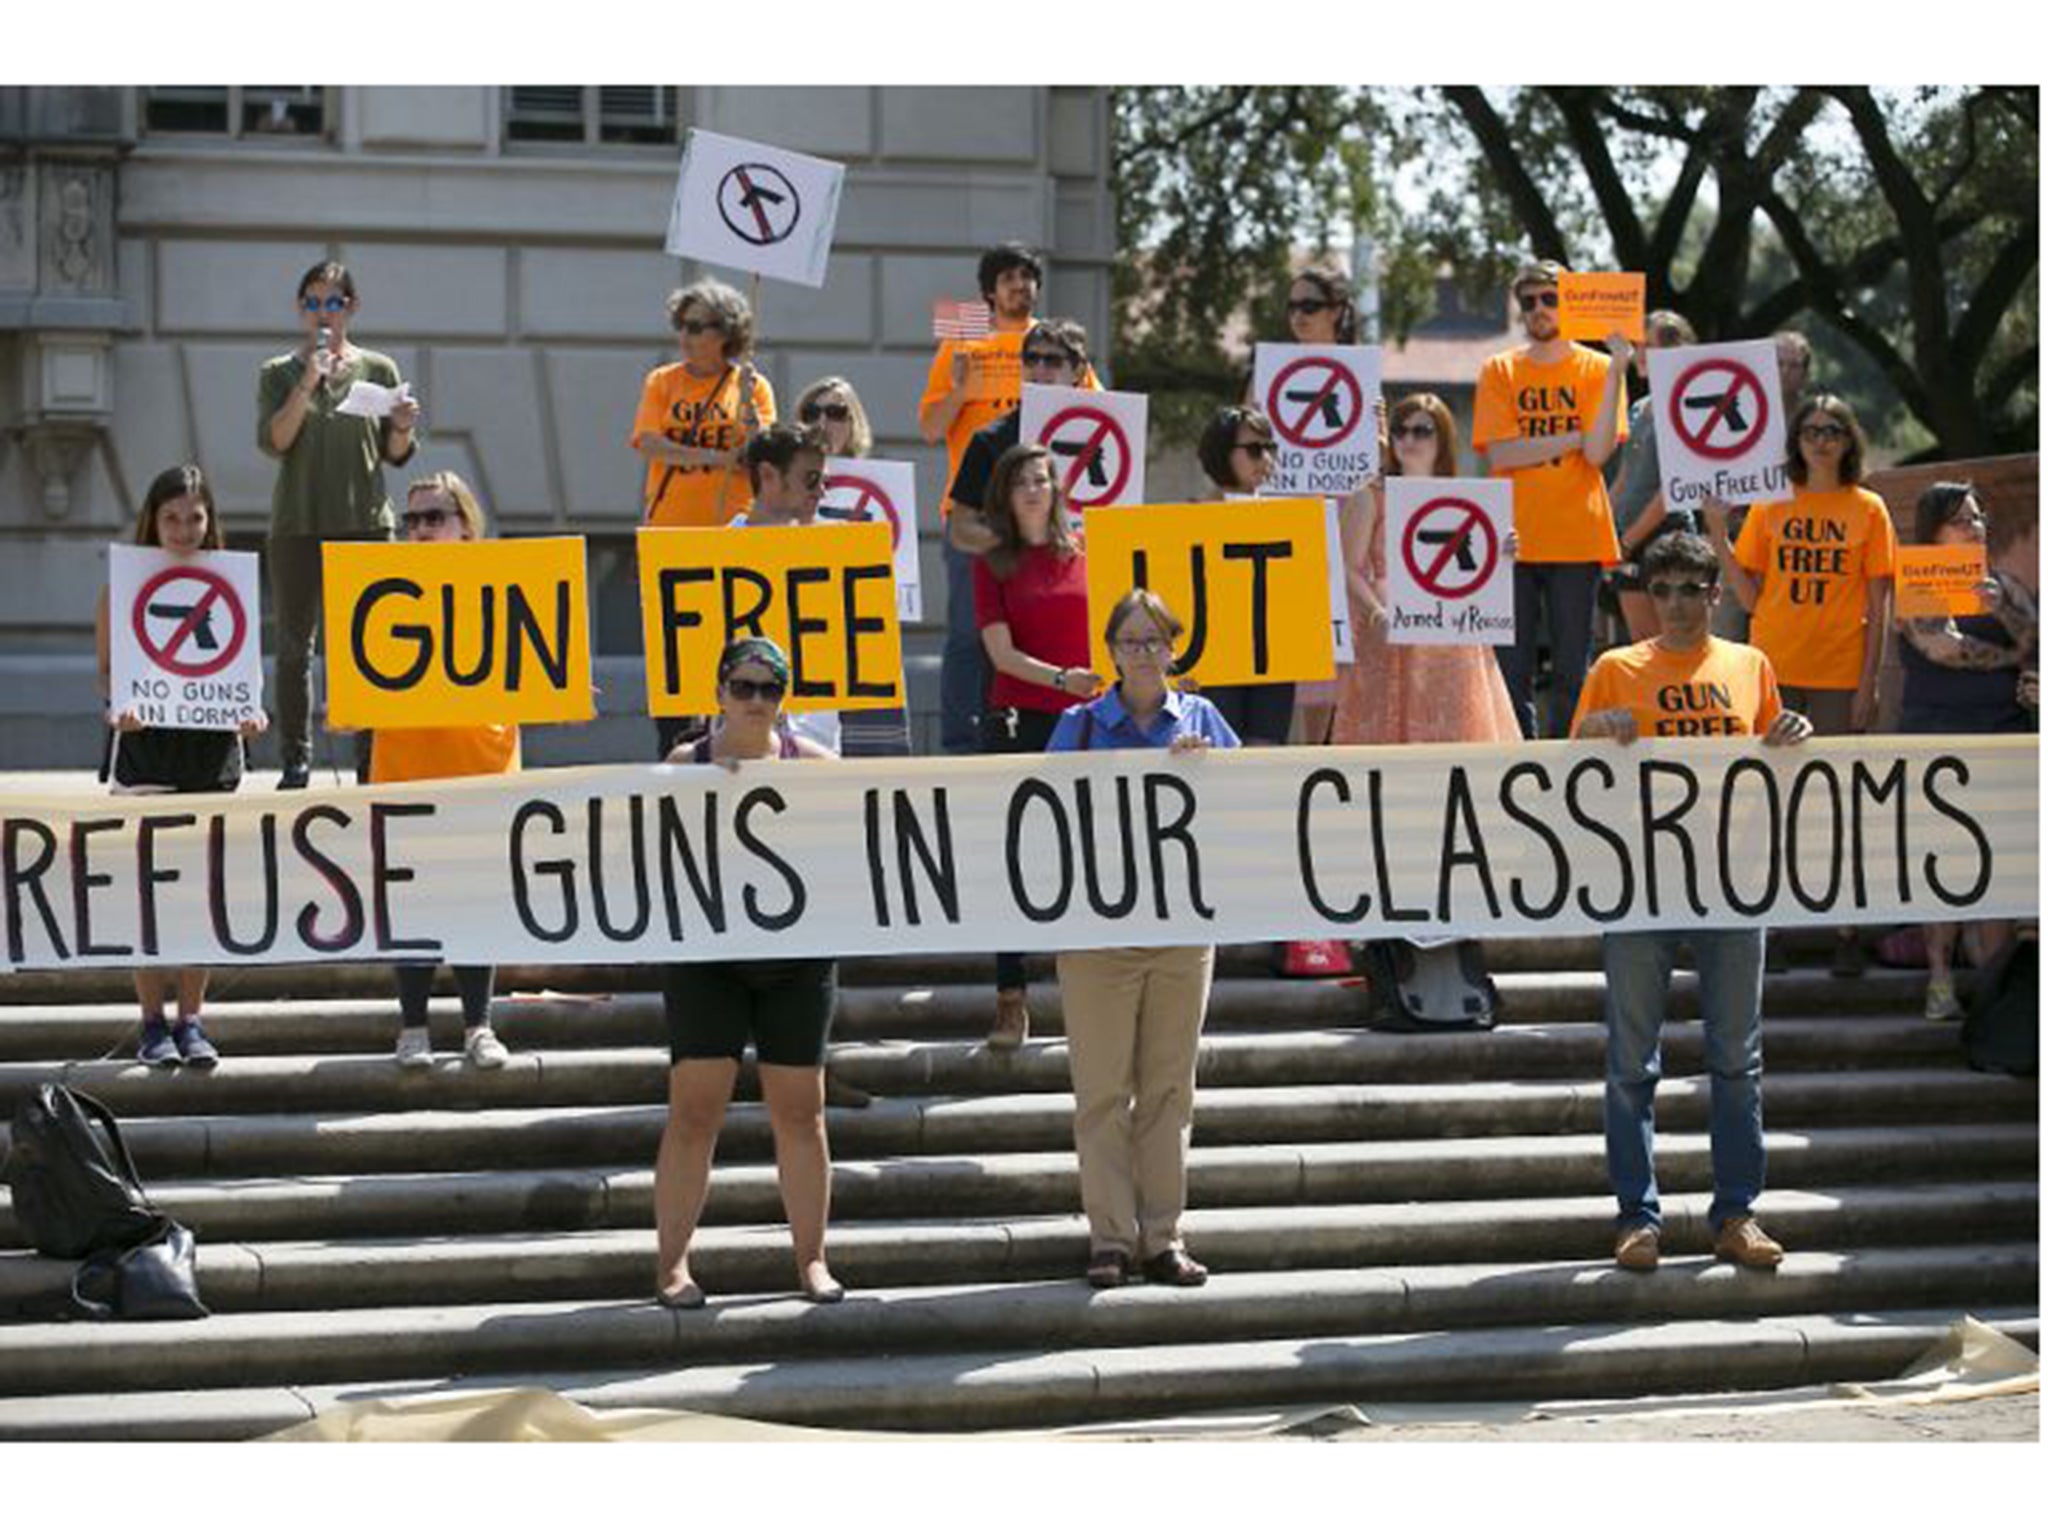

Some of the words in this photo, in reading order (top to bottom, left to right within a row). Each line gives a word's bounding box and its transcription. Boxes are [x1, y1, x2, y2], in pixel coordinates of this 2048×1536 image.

[1518, 385, 1576, 412] GUN
[1518, 414, 1582, 438] FREE
[1312, 452, 1369, 471] GUNS
[1715, 469, 1760, 496] FREE
[1784, 517, 1847, 542] GUN
[1778, 545, 1850, 575] FREE
[1790, 578, 1830, 604] UT
[1131, 540, 1293, 676] UT
[1393, 601, 1443, 629] Armed
[351, 577, 571, 692] GUN
[659, 564, 896, 697] FREE
[132, 679, 171, 699] NO
[183, 682, 250, 703] GUNS
[1657, 683, 1731, 712] GUN
[139, 704, 166, 722] IN
[1656, 716, 1748, 736] FREE
[2, 803, 442, 962] REFUSE
[510, 786, 807, 943] GUNS
[864, 787, 961, 927] IN
[1005, 773, 1215, 922] OUR
[1297, 757, 1992, 923] CLASSROOMS
